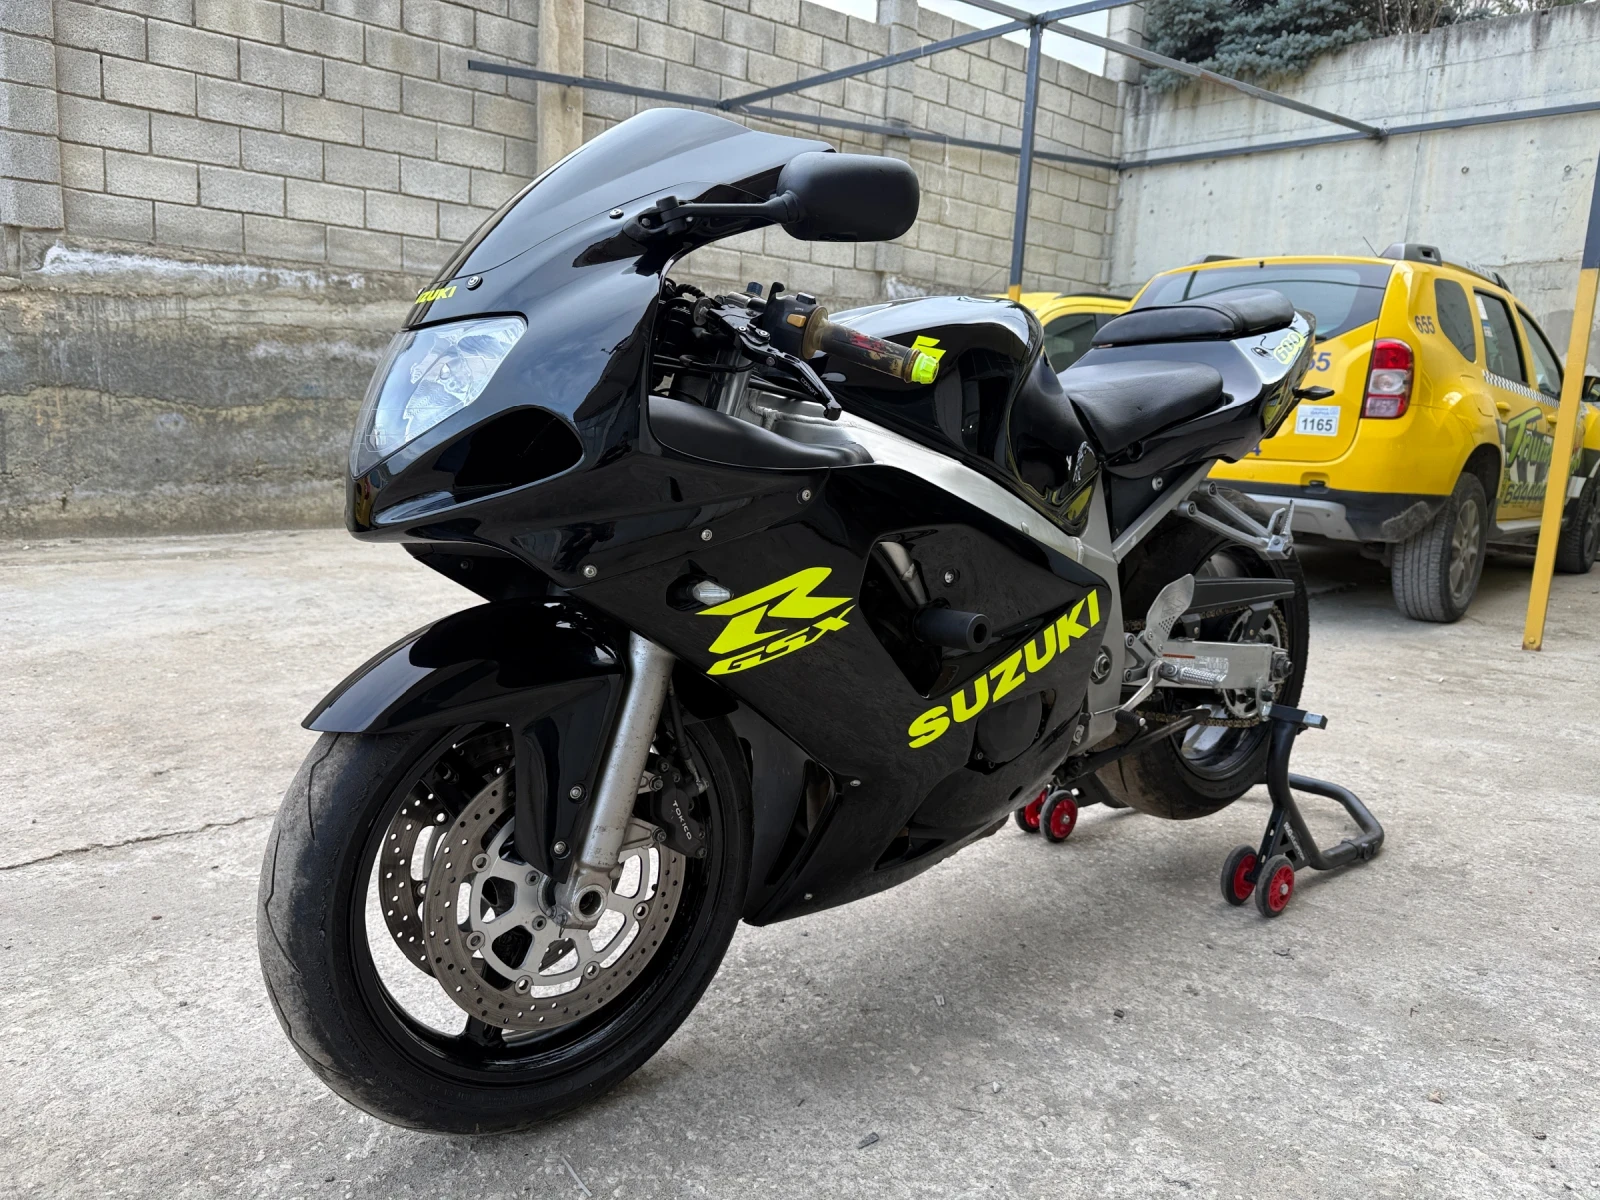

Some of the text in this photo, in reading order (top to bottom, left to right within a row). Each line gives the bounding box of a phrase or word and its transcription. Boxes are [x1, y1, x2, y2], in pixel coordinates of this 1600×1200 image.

[1414, 315, 1435, 335] 655
[1274, 331, 1303, 363] 600
[1302, 417, 1333, 432] 1165
[706, 604, 856, 676] GSX
[908, 589, 1101, 749] SUZUKI
[673, 800, 692, 840] TOKICO
